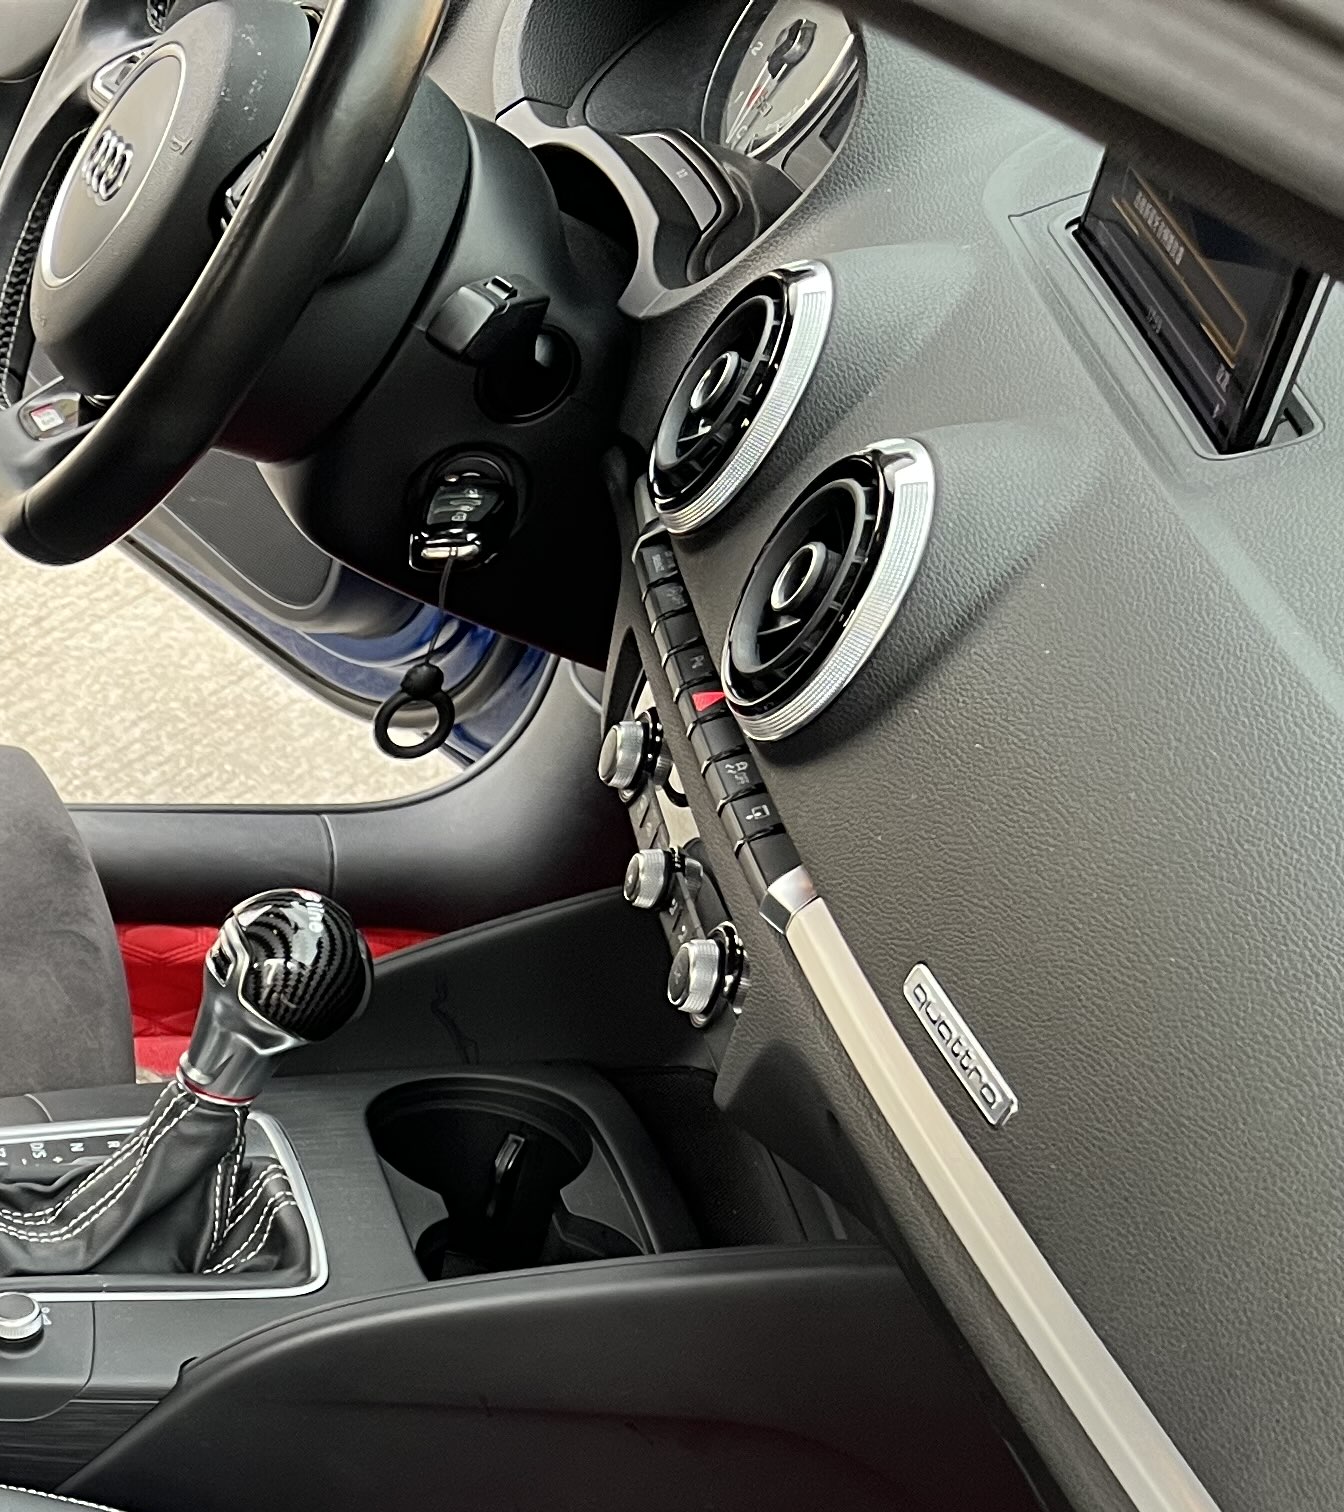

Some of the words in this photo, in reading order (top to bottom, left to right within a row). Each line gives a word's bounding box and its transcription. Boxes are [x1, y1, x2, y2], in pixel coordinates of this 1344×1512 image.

[751, 41, 764, 56] 2
[913, 983, 998, 1110] quattro
[70, 1142, 84, 1152] N
[106, 1140, 121, 1149] R
